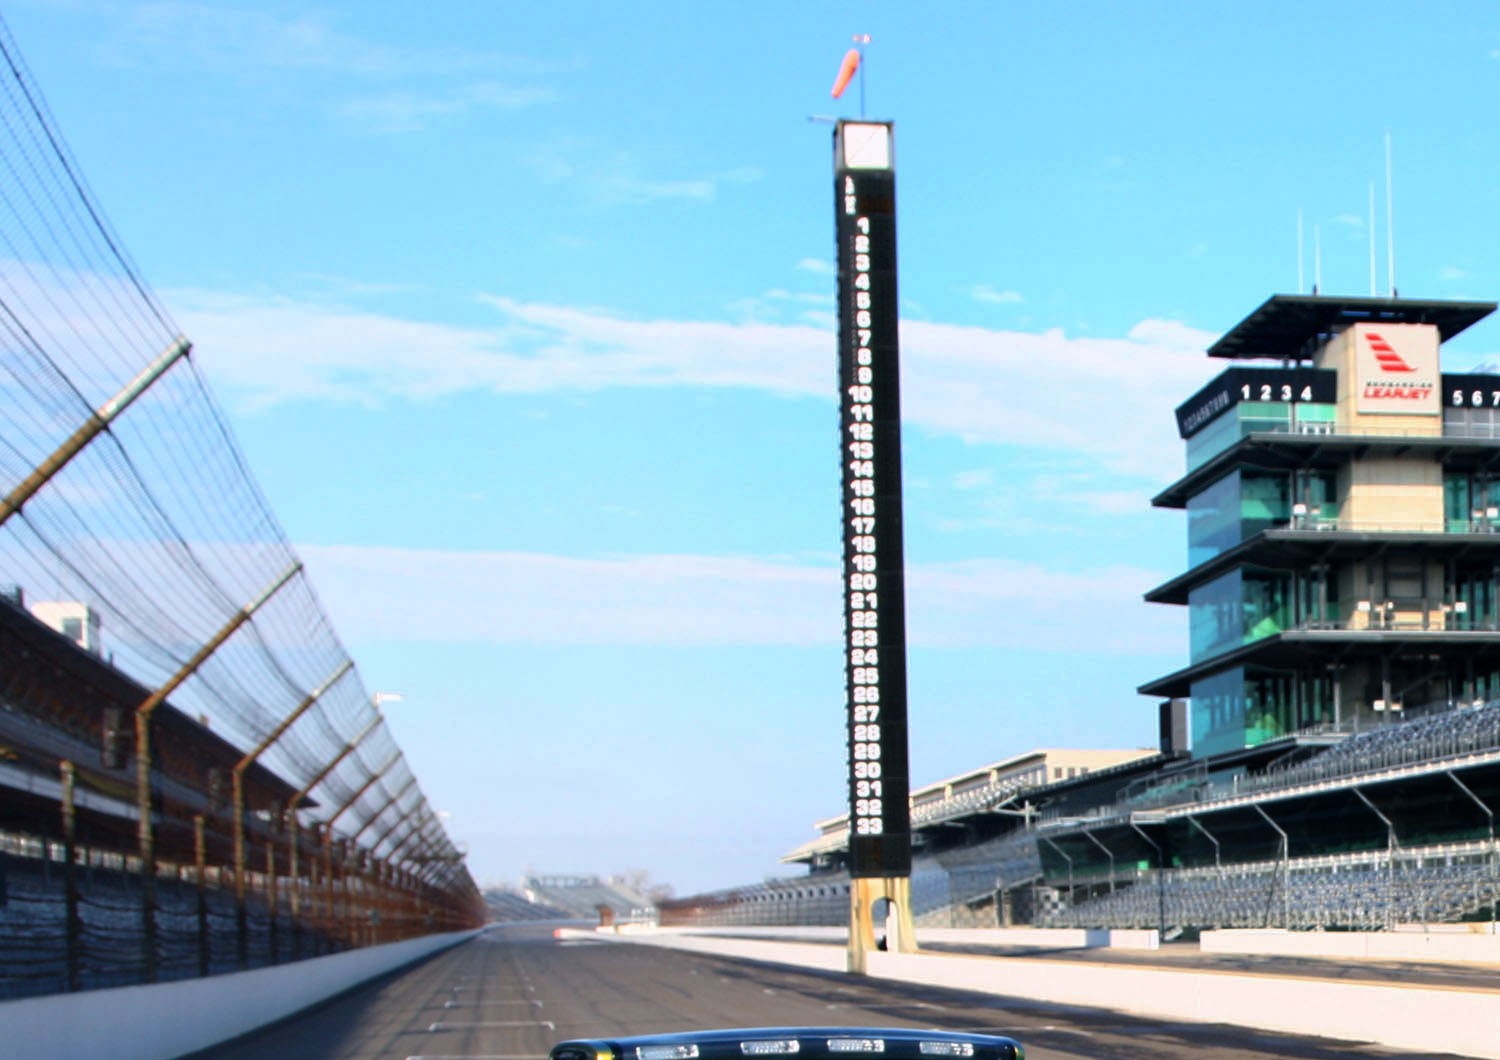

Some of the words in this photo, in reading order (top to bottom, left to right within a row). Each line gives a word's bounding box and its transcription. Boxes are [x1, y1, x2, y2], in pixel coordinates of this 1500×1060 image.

[857, 217, 870, 234] 1
[855, 235, 870, 253] 2
[855, 254, 870, 272] 3
[855, 273, 870, 291] 4
[857, 292, 871, 309] 5
[857, 310, 871, 328] 6
[858, 329, 872, 347] 7
[857, 348, 872, 366] 8
[858, 367, 872, 384] 9
[848, 385, 872, 403] 10
[1241, 385, 1250, 400] 1
[1261, 385, 1271, 400] 2
[1281, 385, 1291, 400] 3
[1301, 385, 1312, 400] 4
[1363, 388, 1432, 400] LEARJET
[1453, 390, 1463, 405] 5
[1472, 391, 1482, 405] 6
[851, 404, 873, 422] 11
[849, 423, 873, 441] 12
[849, 442, 873, 459] 13
[850, 460, 874, 478] 14
[850, 479, 874, 497] 15
[851, 498, 875, 515] 16
[851, 517, 875, 534] 17
[851, 536, 876, 553] 18
[852, 554, 876, 572] 19
[850, 573, 877, 590] 20
[851, 592, 877, 609] 21
[852, 611, 877, 628] 22
[852, 630, 878, 647] 23
[851, 648, 878, 665] 24
[853, 667, 879, 684] 25
[854, 686, 879, 703] 26
[854, 705, 879, 722] 27
[854, 724, 880, 741] 28
[854, 743, 881, 760] 29
[855, 762, 881, 779] 30
[857, 780, 882, 797] 31
[856, 799, 882, 816] 32
[857, 817, 883, 835] 33
